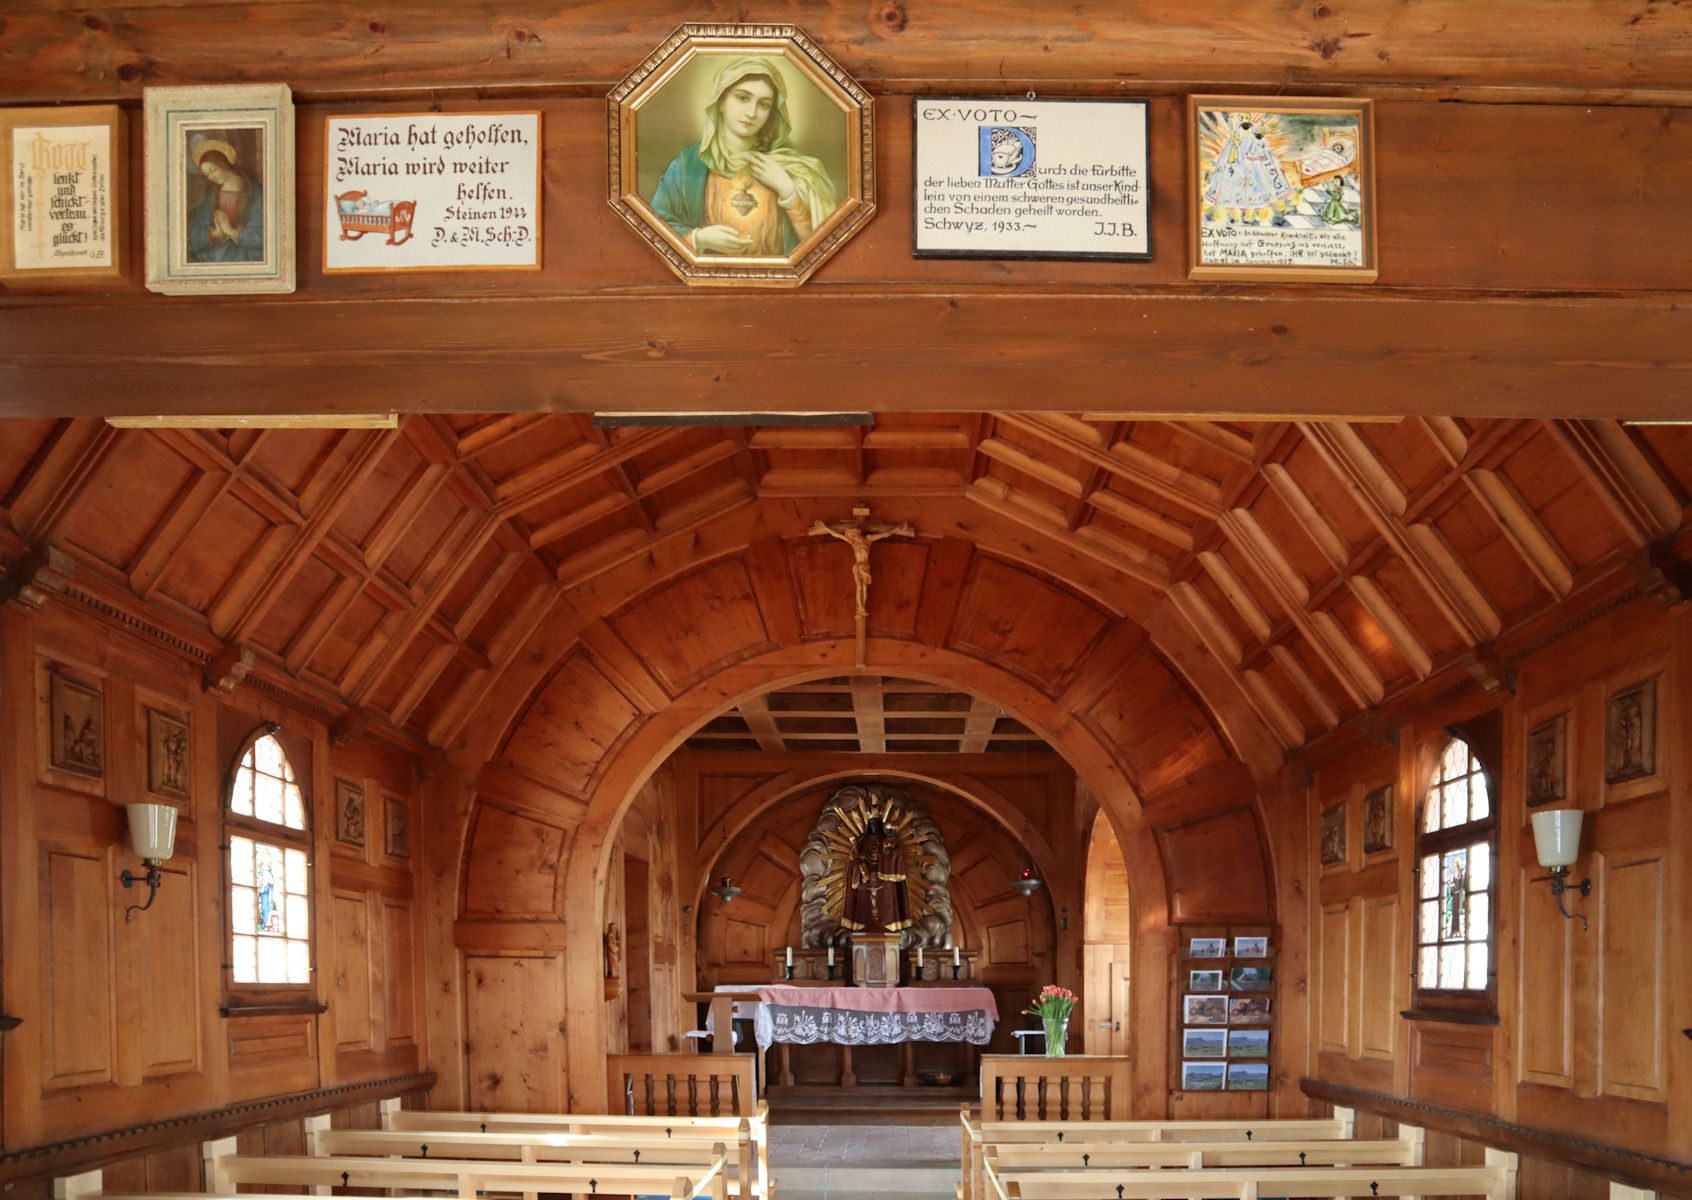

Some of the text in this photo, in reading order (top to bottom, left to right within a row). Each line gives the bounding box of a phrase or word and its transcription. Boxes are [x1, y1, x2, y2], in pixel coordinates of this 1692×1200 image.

[336, 124, 528, 152] Maria hat geholfen,
[336, 156, 510, 182] Maria wird weiter
[1070, 164, 1088, 176] die
[1091, 164, 1137, 177] Fürbitte
[54, 172, 82, 184] lenkt
[924, 176, 944, 188] der
[946, 177, 981, 188] lieben
[984, 177, 1026, 190] Mutter
[1027, 178, 1064, 191] Gottes
[1066, 179, 1080, 191] ist
[1081, 182, 1112, 192] unser
[57, 184, 76, 196] und
[456, 182, 514, 204] helfen.
[924, 189, 945, 201] lein
[949, 193, 972, 202] von
[973, 192, 1008, 202] einem
[1012, 192, 1064, 203] schweren
[443, 207, 497, 222] Steinen
[924, 202, 1102, 220] chen Schaden geheilt worden.
[62, 222, 74, 232] es
[924, 218, 988, 233] Schwyz,
[1202, 227, 1214, 238] EX
[1216, 227, 1237, 237] VOTO
[450, 231, 458, 243] &
[1220, 248, 1247, 258] MARIA
